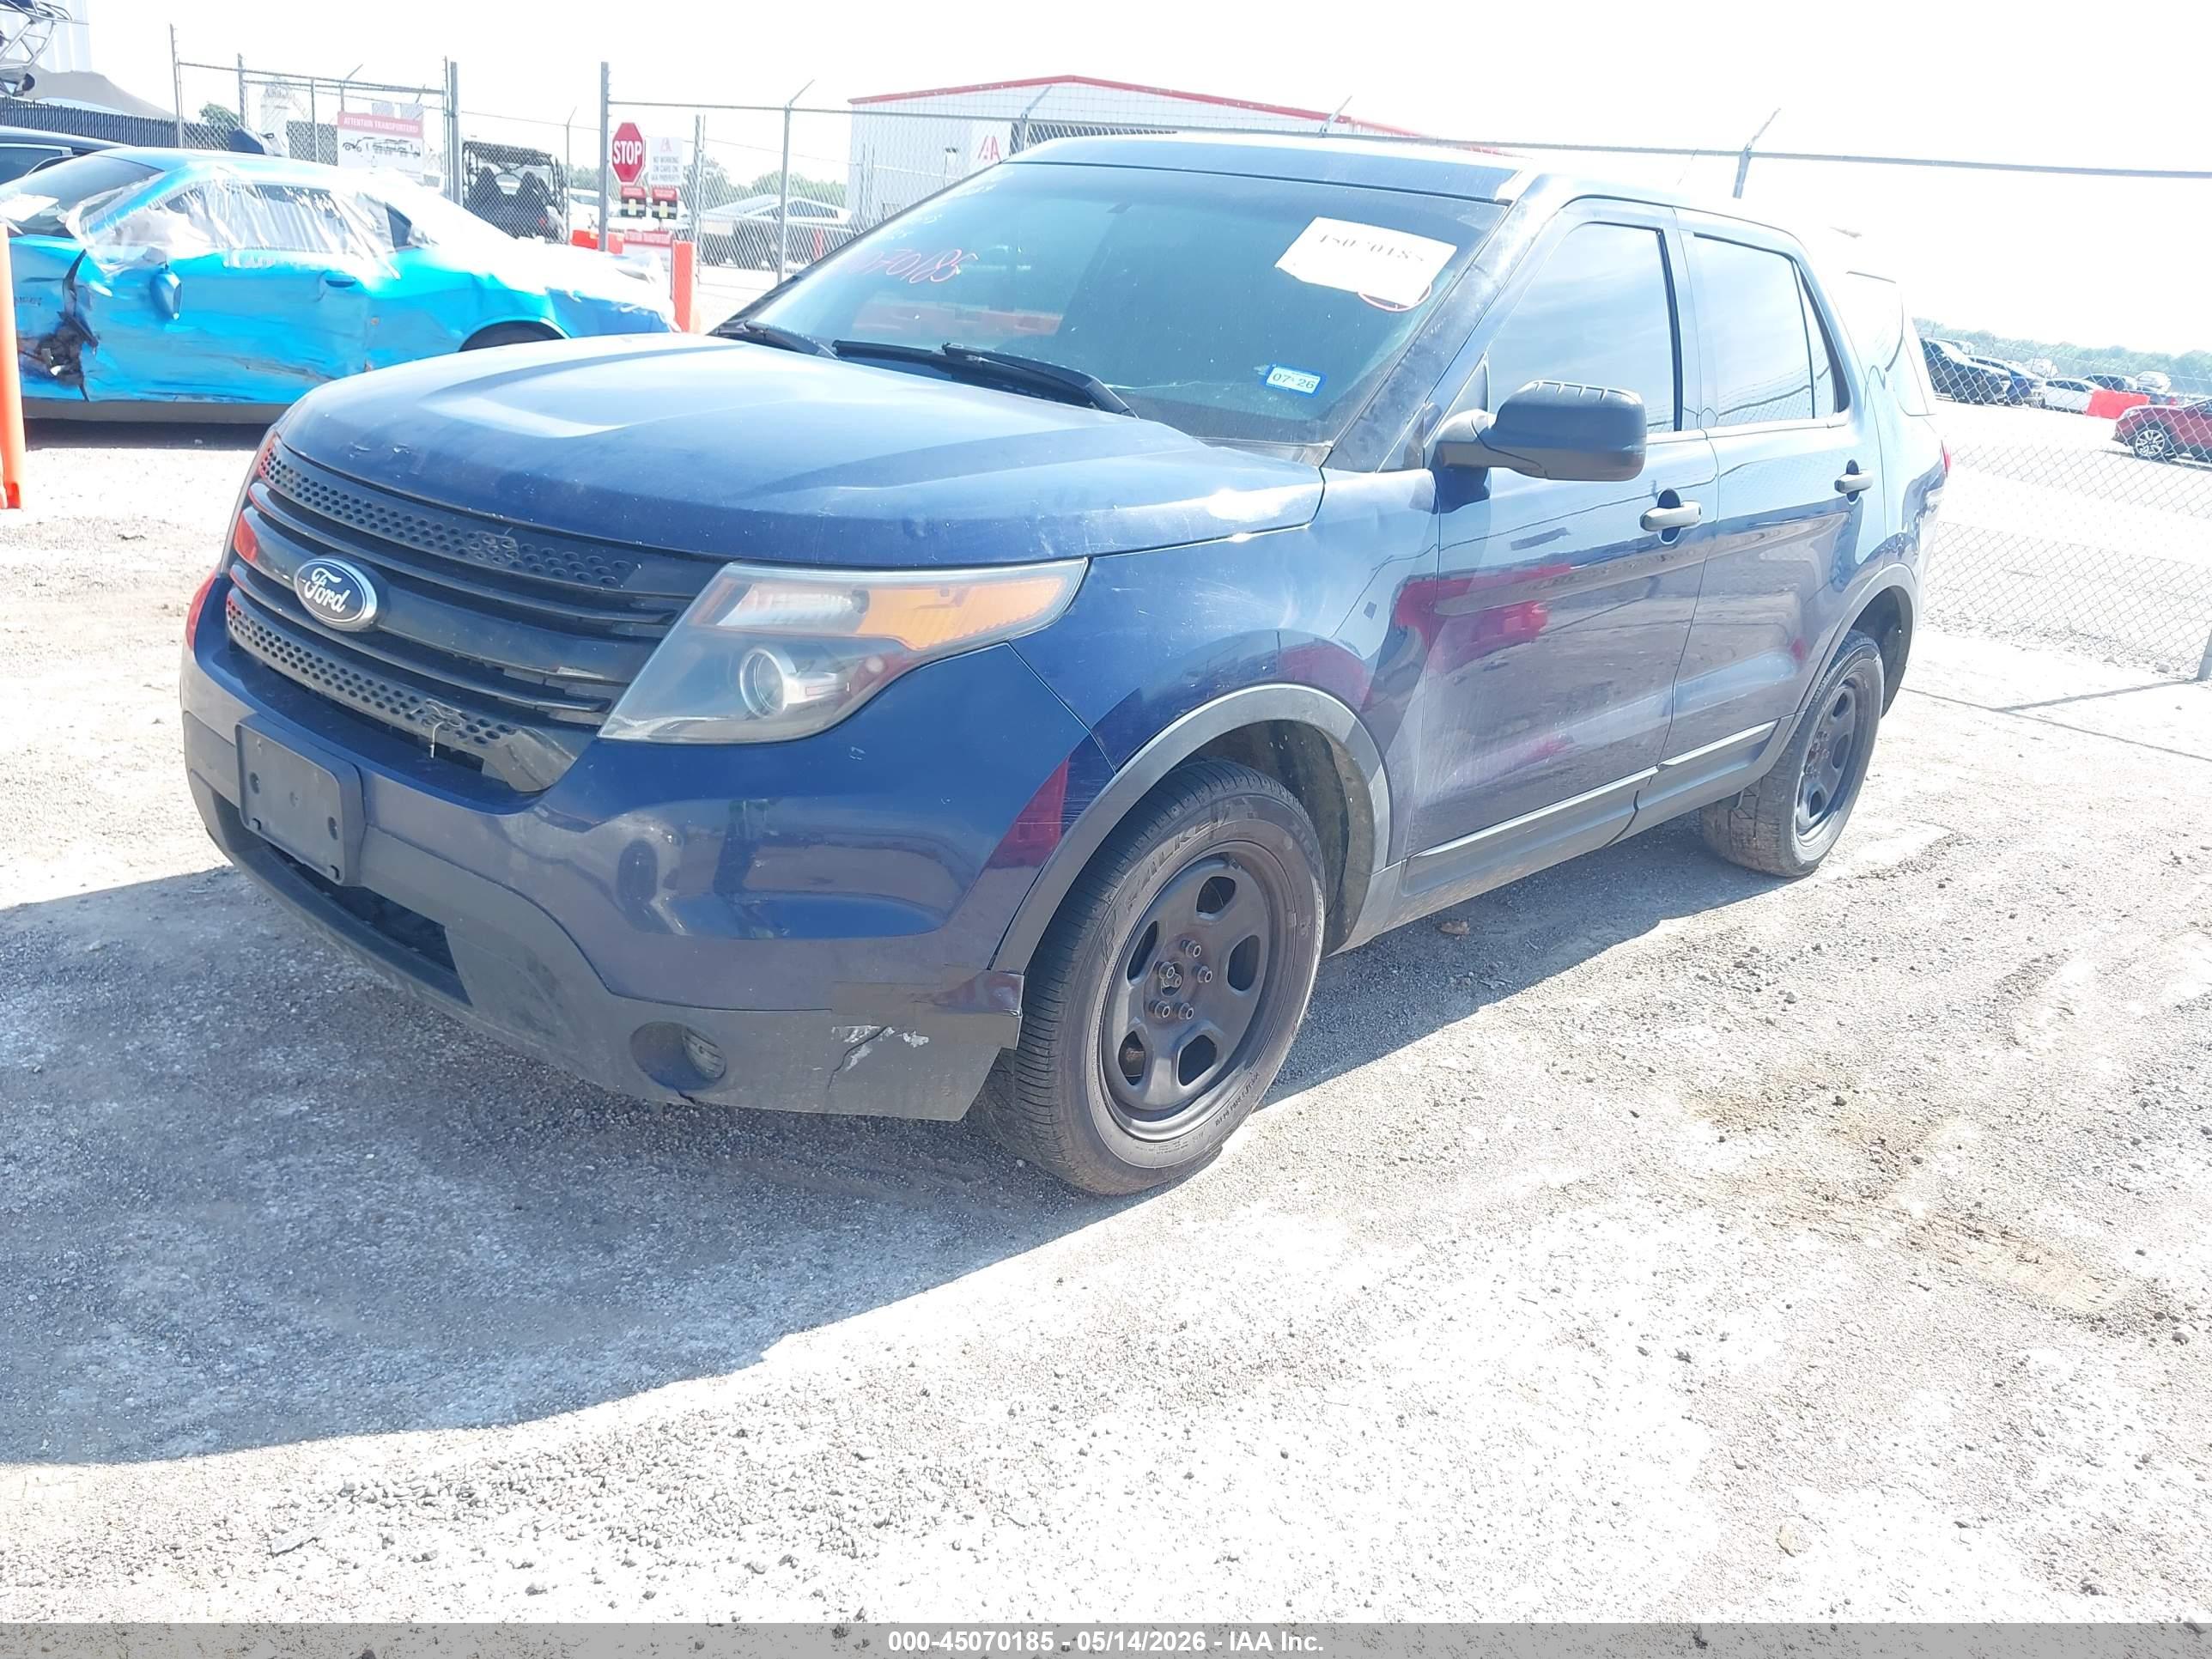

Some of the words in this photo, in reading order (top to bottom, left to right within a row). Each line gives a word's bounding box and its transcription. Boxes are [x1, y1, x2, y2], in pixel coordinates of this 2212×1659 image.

[613, 140, 642, 165] STOP
[1297, 378, 1316, 389] 26
[304, 568, 350, 612] Ford
